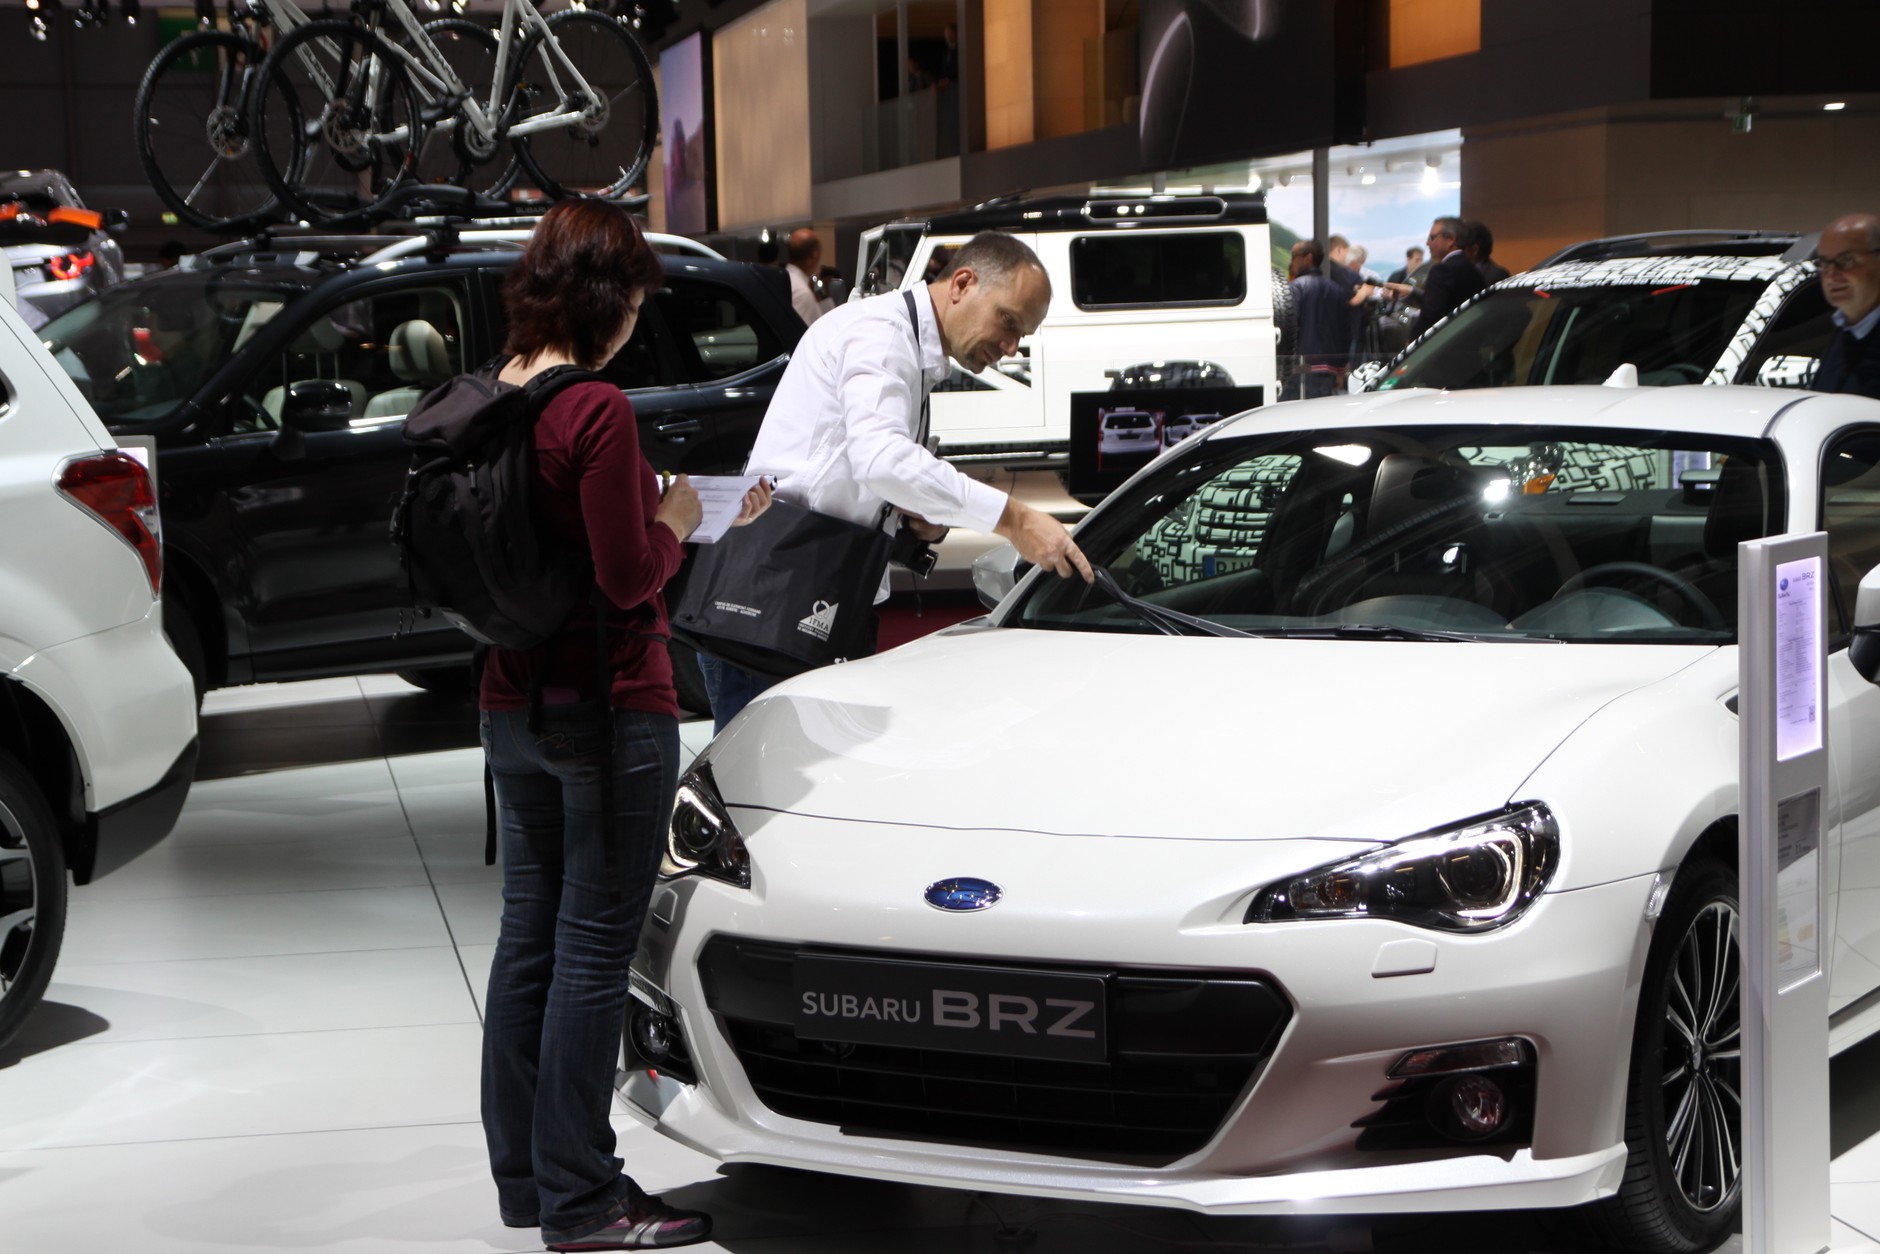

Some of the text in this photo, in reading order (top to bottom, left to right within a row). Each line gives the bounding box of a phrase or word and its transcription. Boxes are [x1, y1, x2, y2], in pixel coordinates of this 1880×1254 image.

[303, 46, 336, 91] SUBAR
[418, 31, 458, 86] SUBARU
[809, 616, 829, 632] IFMA
[802, 988, 1096, 1039] SUBARU BRZ
